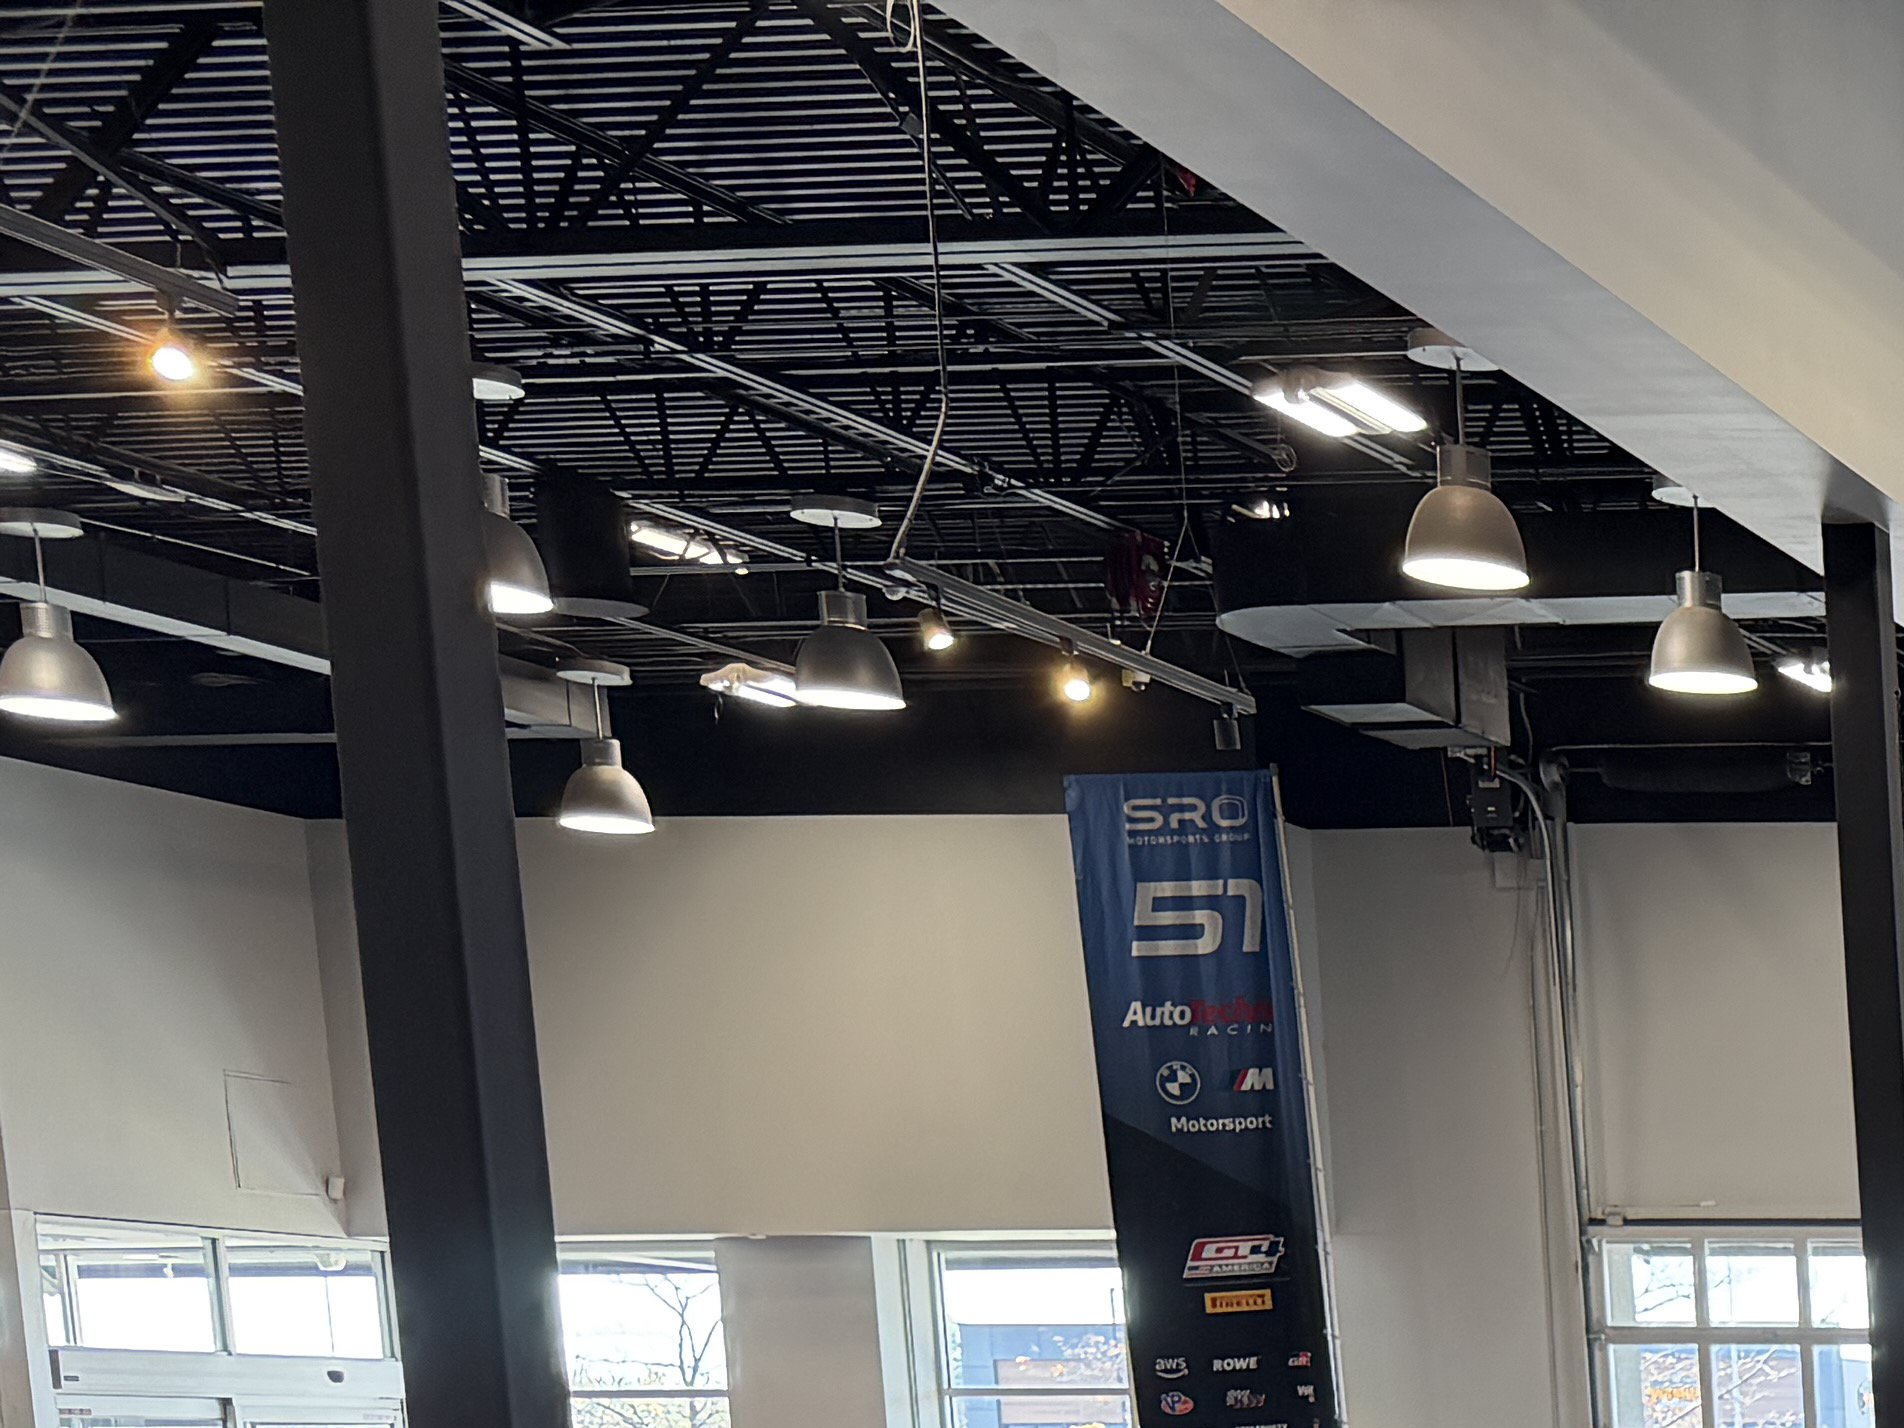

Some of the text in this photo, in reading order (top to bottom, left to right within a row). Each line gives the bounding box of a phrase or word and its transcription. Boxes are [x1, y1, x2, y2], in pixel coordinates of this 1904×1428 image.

[1123, 795, 1249, 831] SRO
[1127, 832, 1251, 846] MOTORSPORTS GROUP
[1131, 878, 1264, 957] 51
[1240, 1067, 1275, 1091] M
[1170, 1114, 1273, 1134] Motorsport
[1201, 1237, 1285, 1259] GT4
[1212, 1262, 1271, 1274] AMERICA
[1155, 1357, 1258, 1371] aws ROWE
